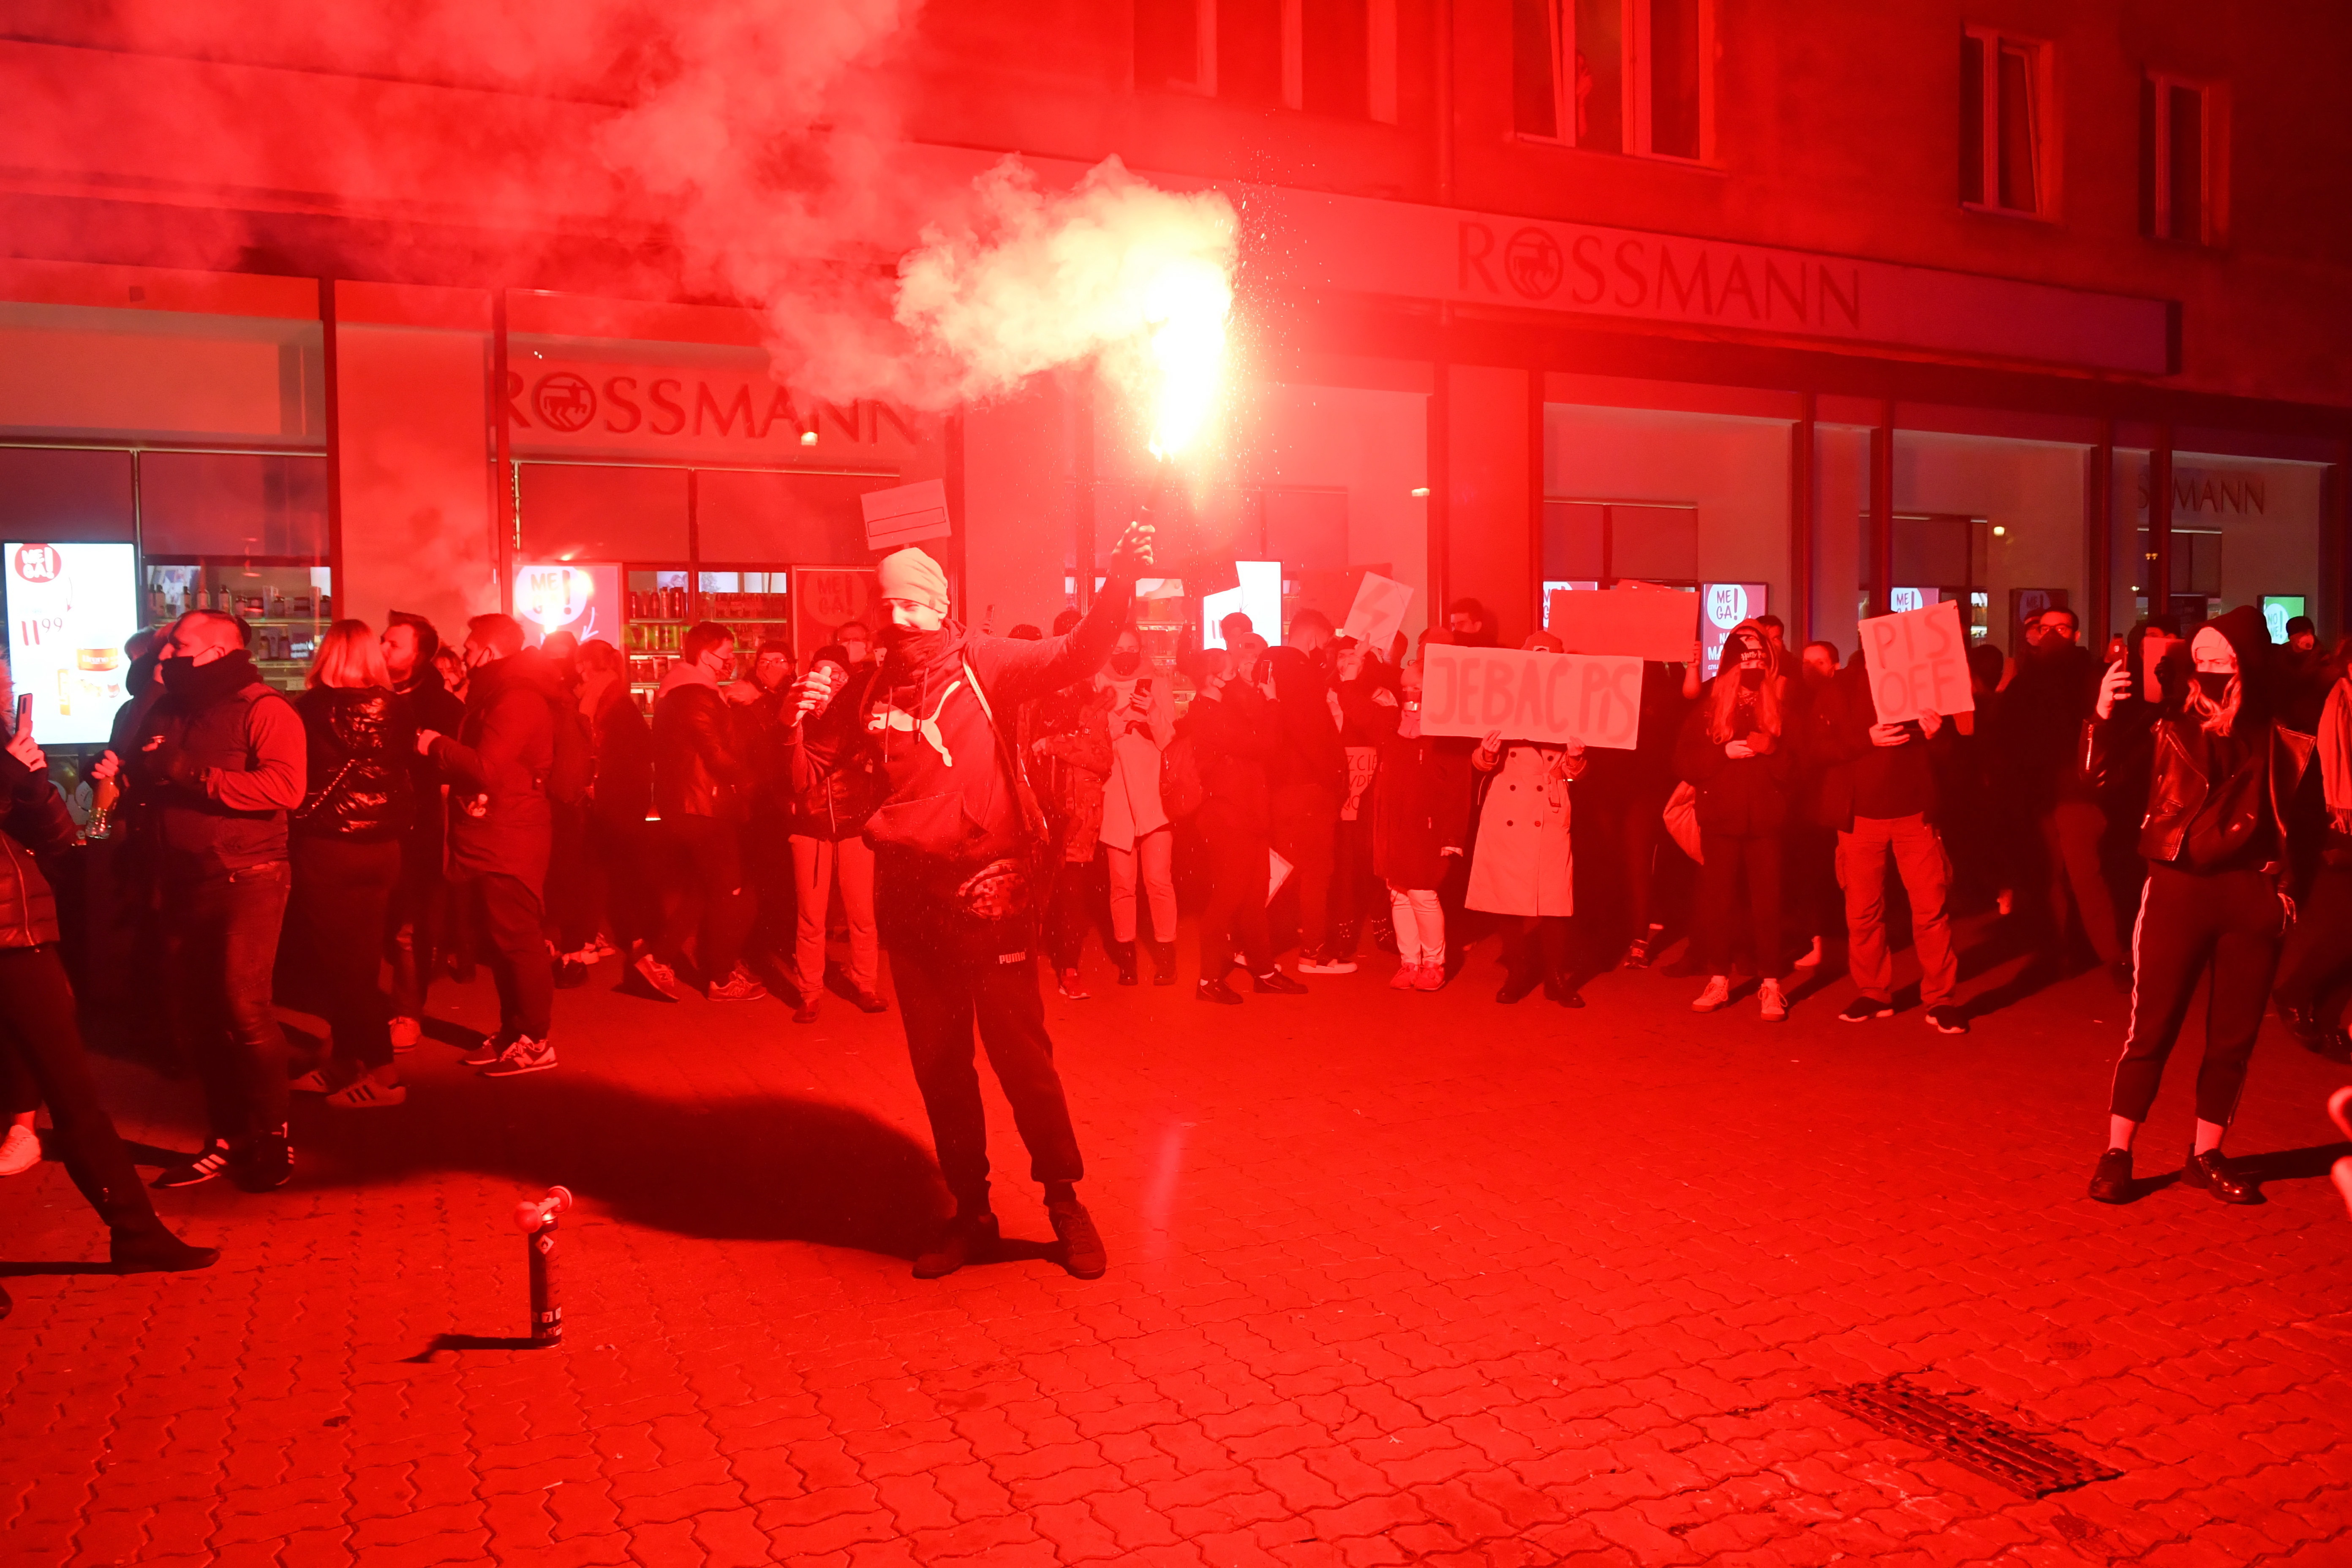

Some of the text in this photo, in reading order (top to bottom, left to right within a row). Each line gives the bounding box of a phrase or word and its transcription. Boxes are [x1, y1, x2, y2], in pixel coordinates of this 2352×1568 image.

[1458, 220, 1859, 329] ROSSMANN
[1717, 590, 1731, 603] ME
[1873, 610, 1951, 669] PIS
[1878, 659, 1957, 716] OFF
[999, 951, 1026, 964] PUMA
